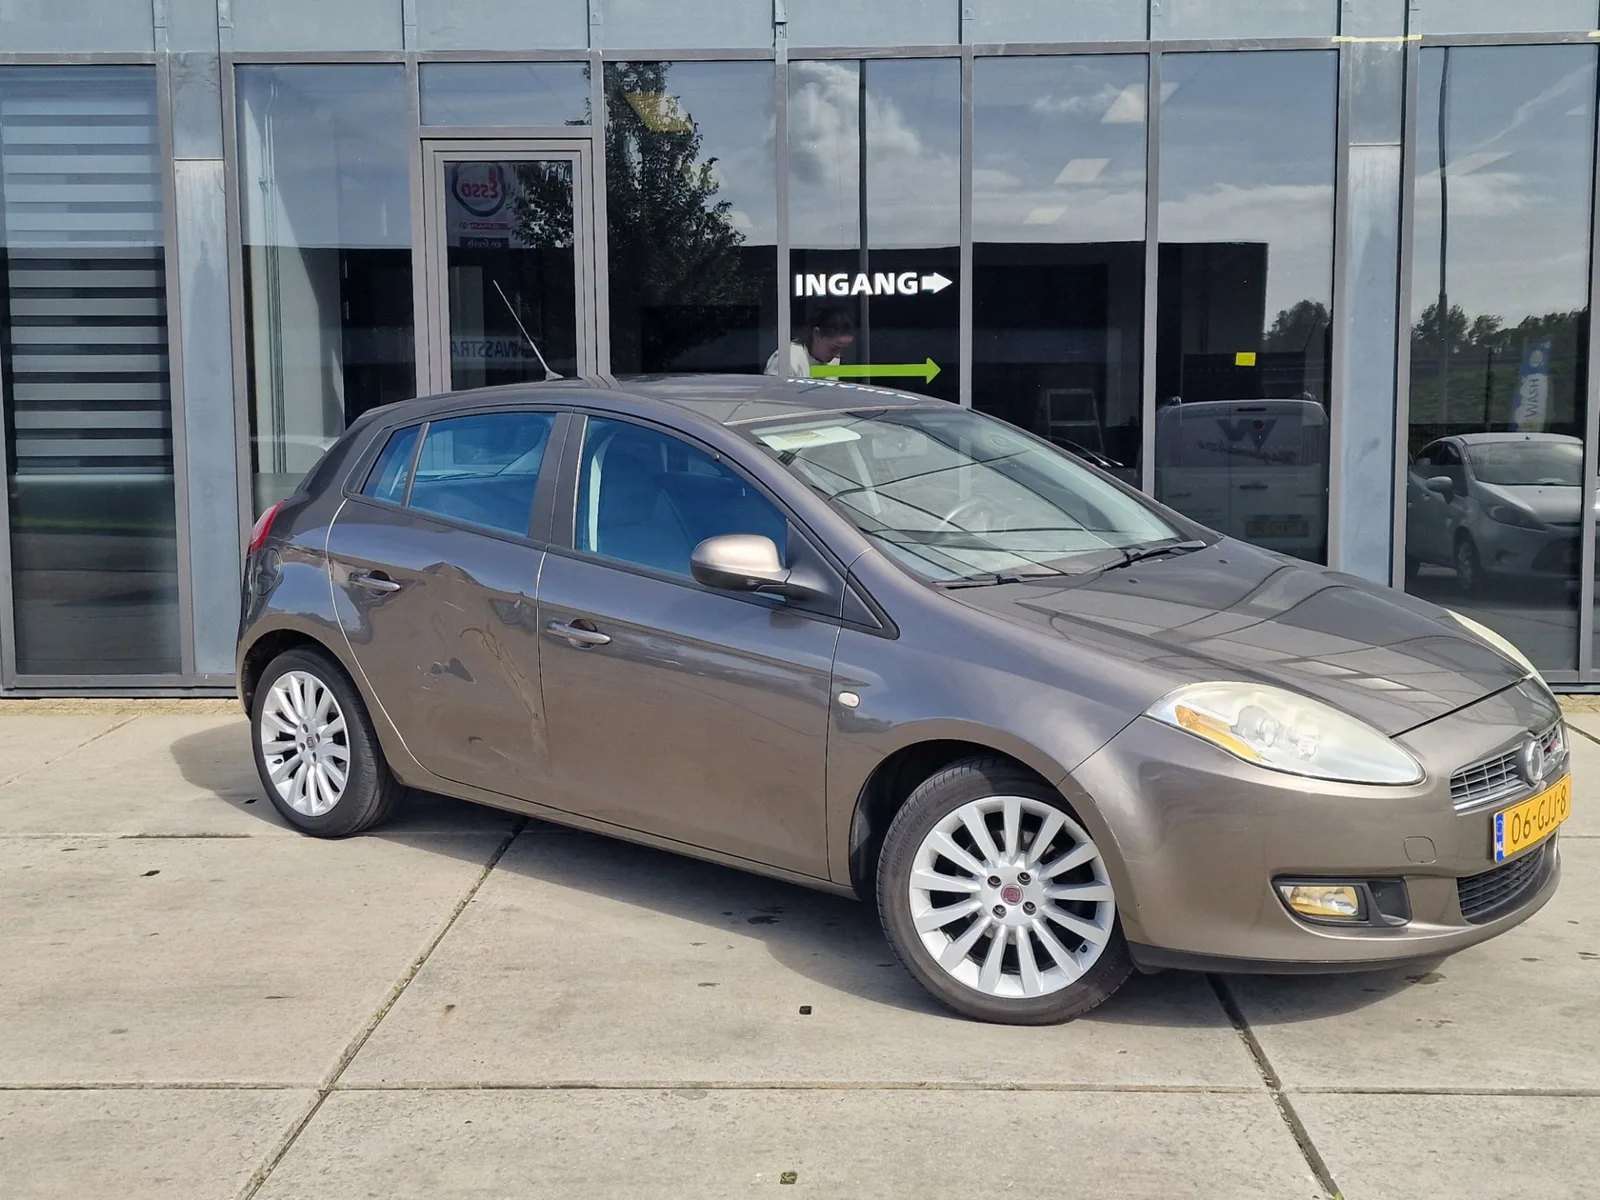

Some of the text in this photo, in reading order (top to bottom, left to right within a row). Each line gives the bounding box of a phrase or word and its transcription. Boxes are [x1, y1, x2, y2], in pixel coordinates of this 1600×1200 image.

[795, 271, 918, 297] INGANG
[1524, 378, 1541, 418] WASH
[1511, 784, 1567, 846] 06-GJJ-8
